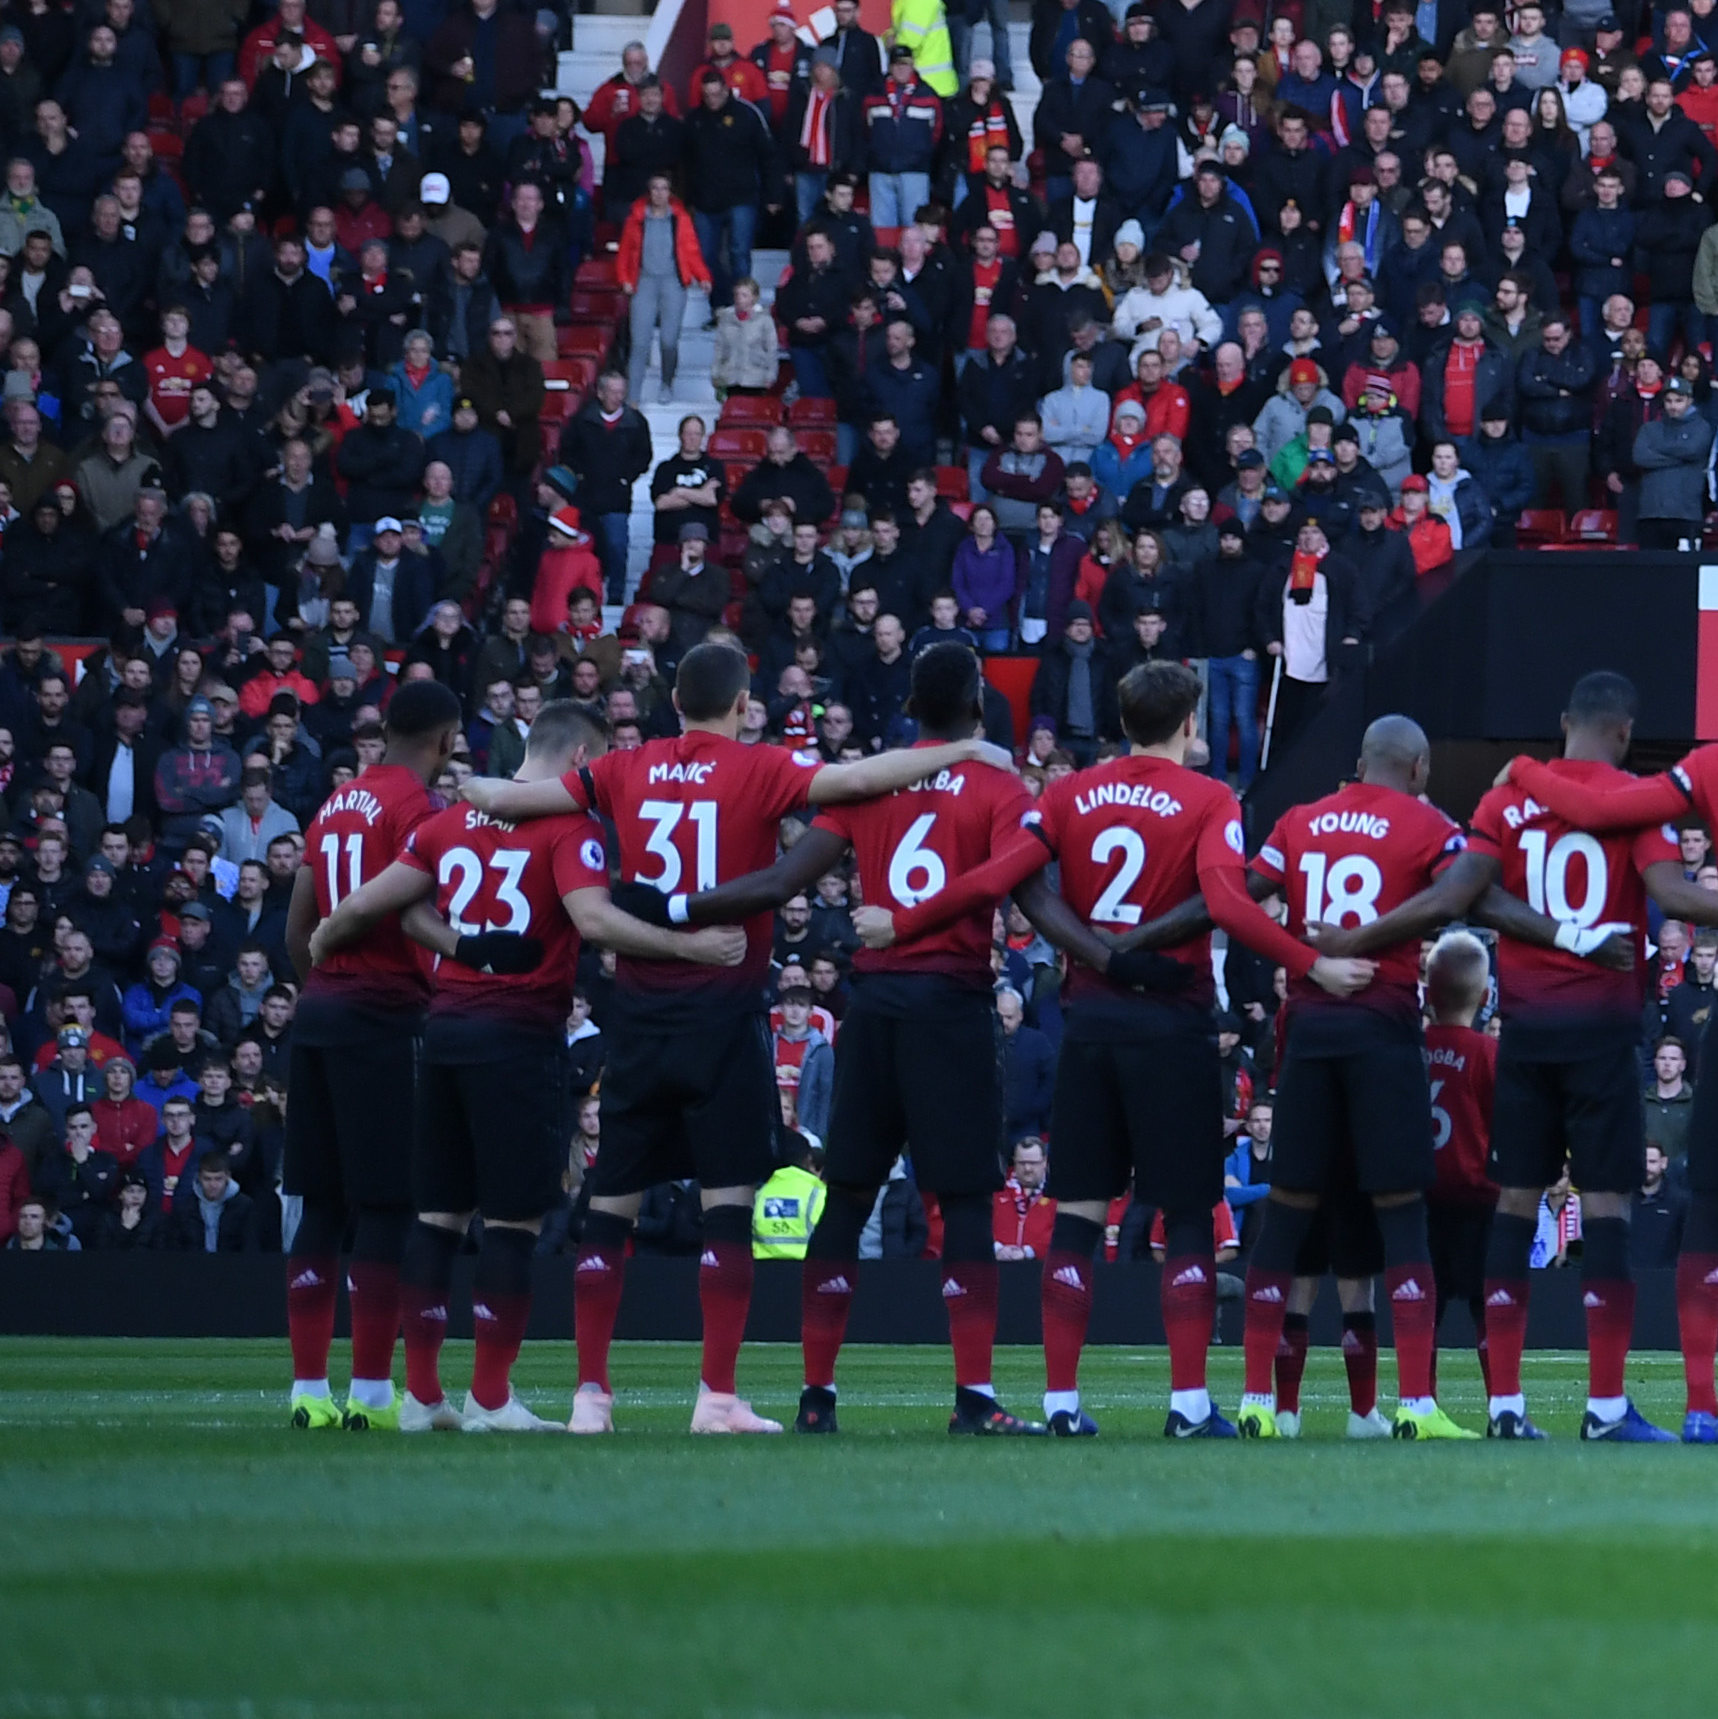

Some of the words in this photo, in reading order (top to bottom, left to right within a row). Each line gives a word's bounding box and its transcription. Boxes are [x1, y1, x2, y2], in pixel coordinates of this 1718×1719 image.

[319, 790, 383, 827] MARTIAL
[1075, 783, 1182, 817] LINDELOF
[1309, 811, 1390, 839] YOUNG
[320, 833, 363, 913] 11
[634, 800, 717, 894] 31
[888, 813, 946, 908] 6
[1090, 825, 1145, 924] 2
[1518, 829, 1608, 929] 10
[438, 846, 532, 936] 23
[1299, 852, 1382, 937] 18
